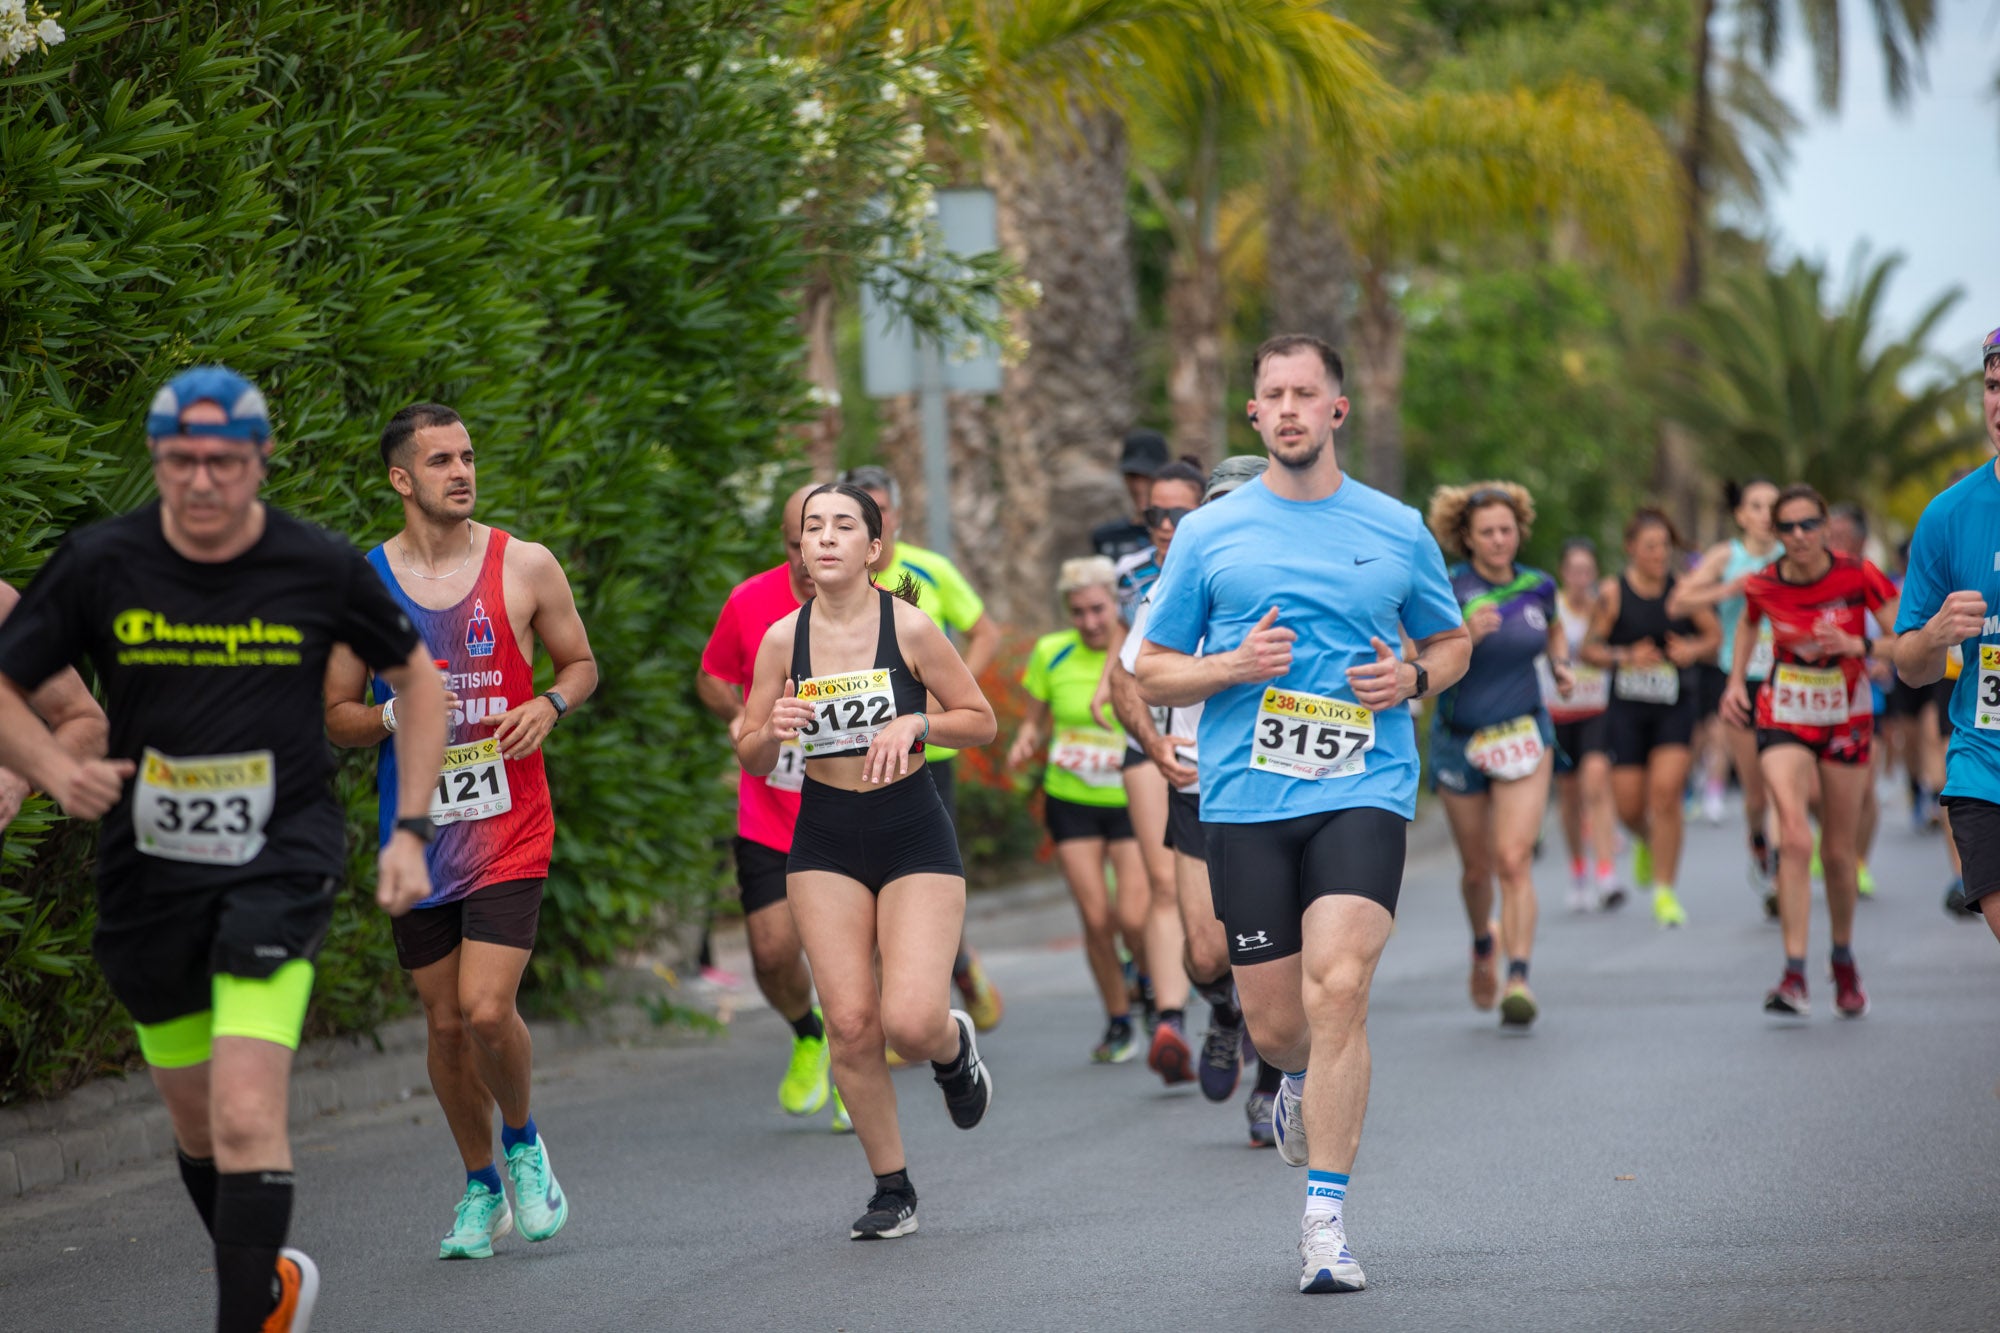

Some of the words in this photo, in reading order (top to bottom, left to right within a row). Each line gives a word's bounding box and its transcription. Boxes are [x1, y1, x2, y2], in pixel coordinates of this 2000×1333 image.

[113, 608, 304, 655] Champion
[804, 684, 817, 696] 38
[817, 680, 868, 696] FONDO
[1779, 688, 1844, 711] 2152
[1276, 695, 1296, 710] 38
[1295, 702, 1352, 720] FONDO
[1258, 718, 1370, 760] 3157
[155, 796, 251, 834] 323
